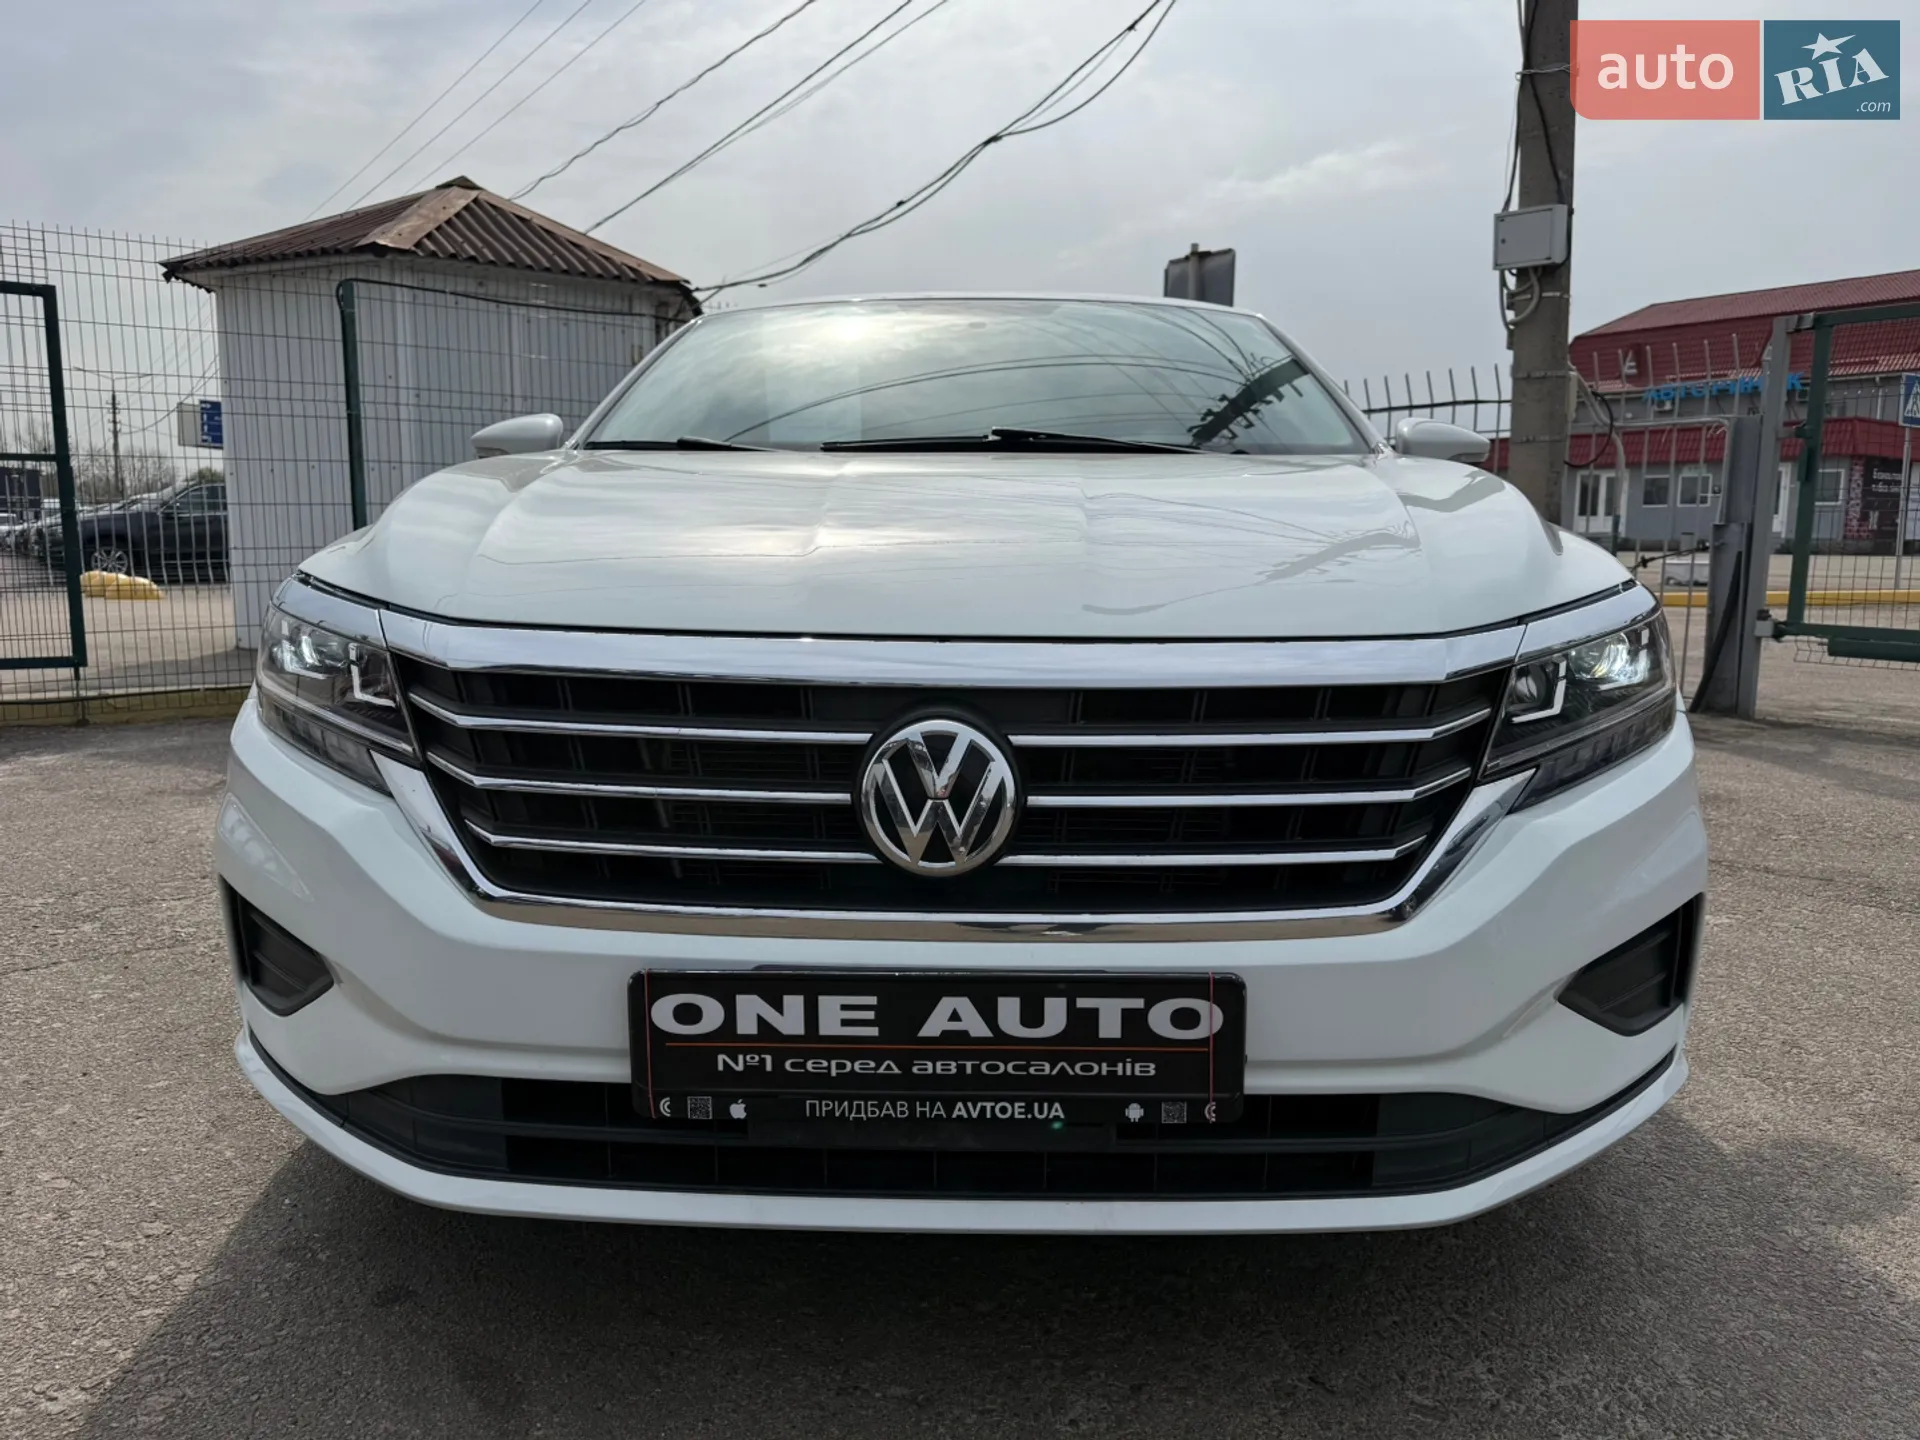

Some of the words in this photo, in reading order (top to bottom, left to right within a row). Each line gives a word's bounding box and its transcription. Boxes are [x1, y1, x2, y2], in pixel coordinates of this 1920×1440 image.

[651, 993, 879, 1037] ONE
[917, 996, 1224, 1040] AUTO
[784, 1058, 902, 1077] серед
[912, 1058, 1156, 1077] автосалонів
[805, 1100, 910, 1121] ПРИДБАВ
[916, 1101, 947, 1119] НА
[952, 1101, 1065, 1119] AVTOE.UA
